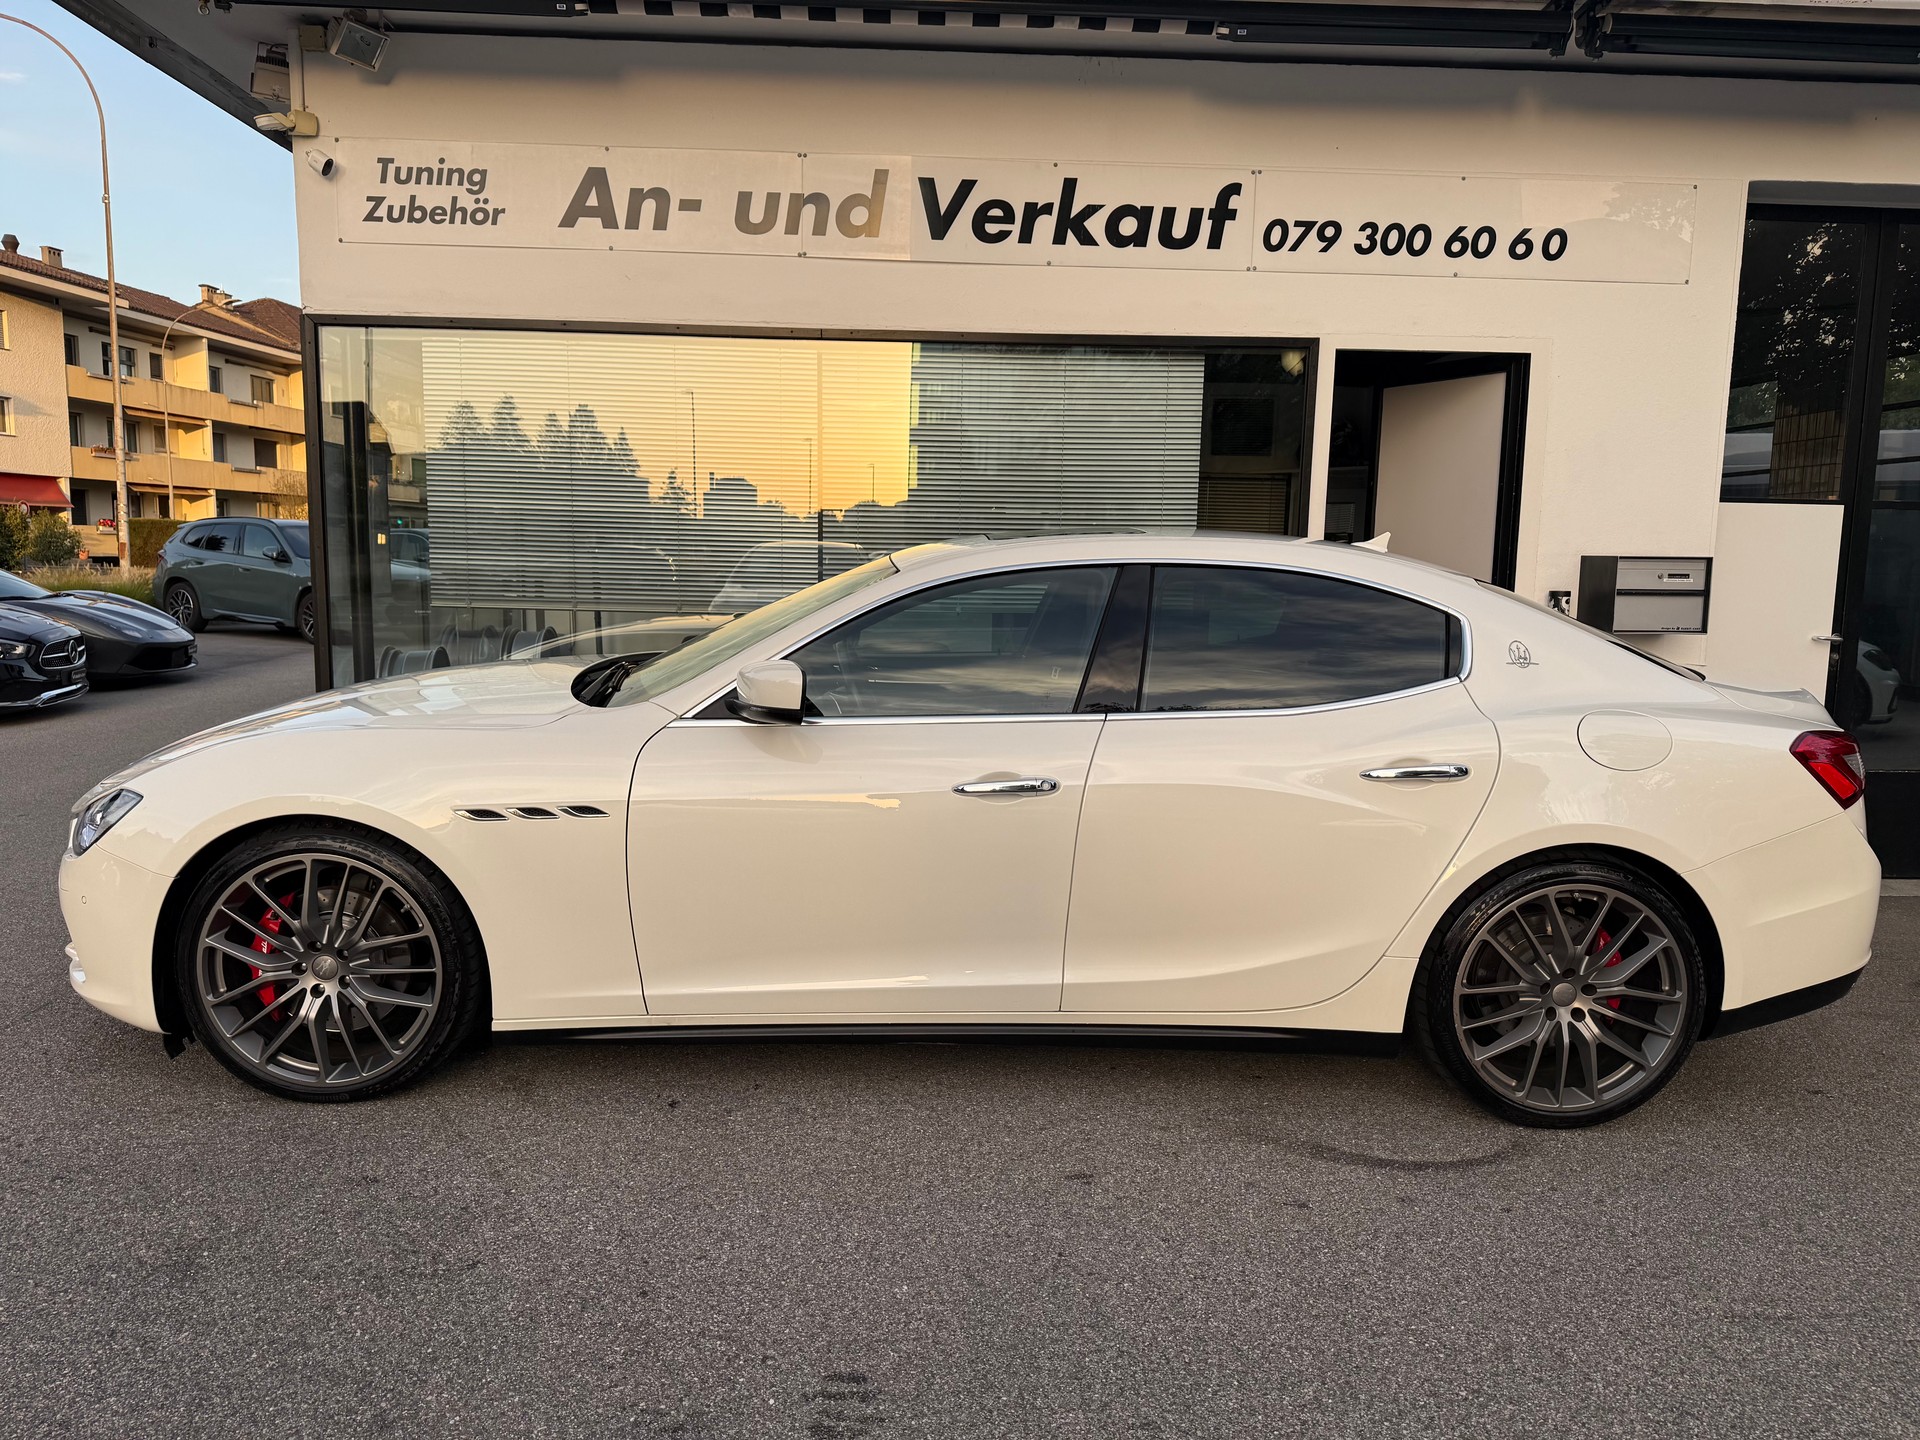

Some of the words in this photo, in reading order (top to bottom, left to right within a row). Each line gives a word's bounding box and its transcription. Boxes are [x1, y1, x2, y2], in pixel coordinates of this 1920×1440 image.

[377, 157, 488, 196] Tuning
[362, 195, 506, 226] Zubehör
[558, 167, 703, 230] An-
[735, 169, 890, 238] und
[918, 177, 1243, 250] Verkauf
[1263, 218, 1342, 254] 079
[1354, 221, 1433, 258] 300
[1444, 225, 1497, 260] 60
[1508, 227, 1569, 262] 60
